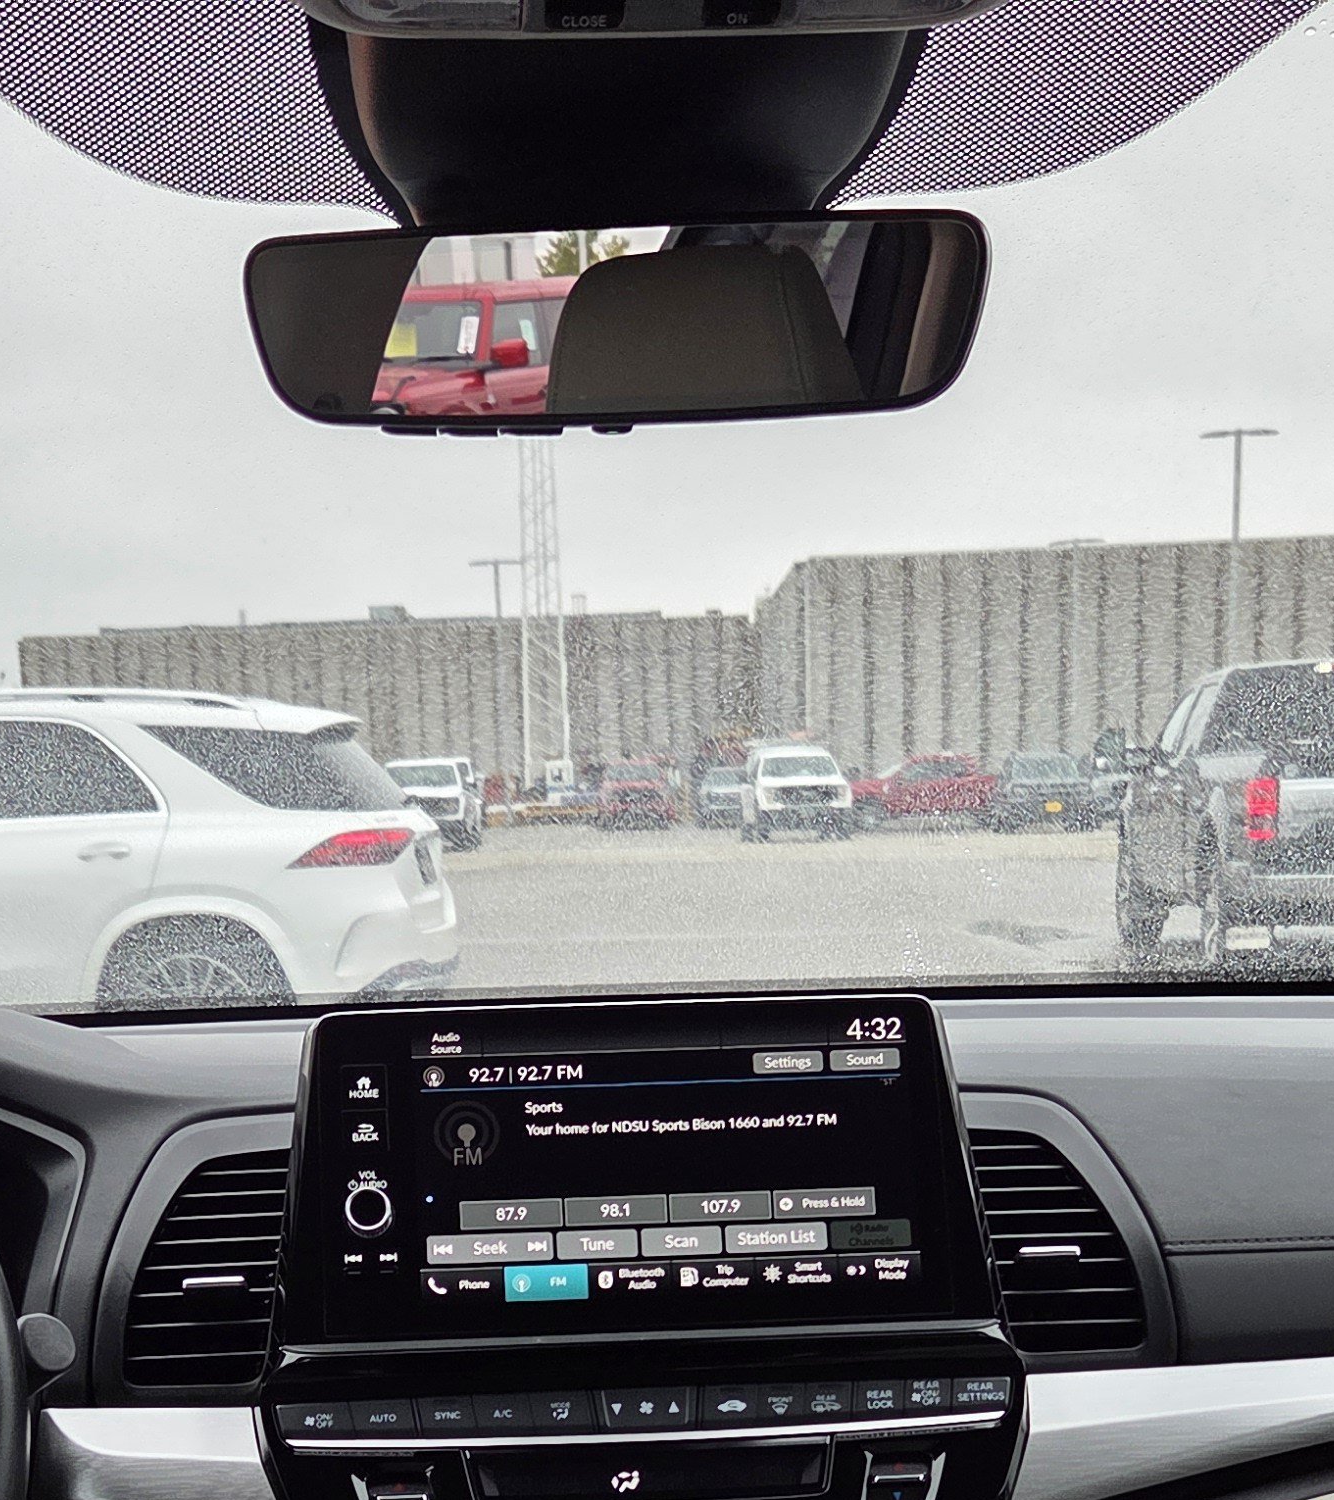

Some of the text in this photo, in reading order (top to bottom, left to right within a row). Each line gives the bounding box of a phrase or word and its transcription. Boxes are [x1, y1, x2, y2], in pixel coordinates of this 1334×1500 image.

[561, 15, 607, 28] CLOSE
[727, 13, 748, 25] ON
[846, 1017, 902, 1040] 4:32
[432, 1032, 461, 1043] Audio
[430, 1044, 462, 1055] Source
[764, 1056, 812, 1070] Settings
[846, 1053, 883, 1066] Sound
[469, 1066, 504, 1083] 92.7
[517, 1065, 553, 1081] 92.7
[556, 1064, 583, 1080] FM
[348, 1088, 379, 1099] HOME
[525, 1101, 563, 1115] Sports
[526, 1113, 837, 1136] Your home for NDSU Sports Bison 1660 and 92.7 FM
[352, 1132, 379, 1142] BACK
[453, 1147, 483, 1166] FM
[358, 1170, 377, 1180] VOL
[359, 1180, 387, 1190] AUDIO
[701, 1199, 741, 1214] 107.9
[802, 1196, 866, 1209] Press & Hold
[495, 1206, 528, 1221] 87.9
[600, 1203, 630, 1218] 98.1
[664, 1234, 698, 1248] Scan
[737, 1229, 816, 1246] Station List
[473, 1240, 508, 1255] Seek
[580, 1237, 615, 1252] Tune
[795, 1261, 822, 1272] Smart
[875, 1258, 909, 1270] Display
[619, 1267, 665, 1279] Bluetooth
[716, 1264, 734, 1277] Trip
[878, 1270, 907, 1281] Mode
[550, 1276, 567, 1288] FM
[628, 1279, 657, 1290] Audio
[703, 1276, 749, 1288] Computer
[787, 1273, 832, 1284] Shortcuts
[458, 1279, 490, 1291] Phone
[913, 1381, 939, 1390] REAR
[967, 1382, 994, 1391] REAR
[867, 1390, 893, 1399] REAR
[957, 1392, 1005, 1402] SETTINGS
[867, 1400, 894, 1410] LOCK
[370, 1413, 397, 1423] AUTO
[434, 1410, 461, 1420] SYNC
[493, 1409, 513, 1419] A/C
